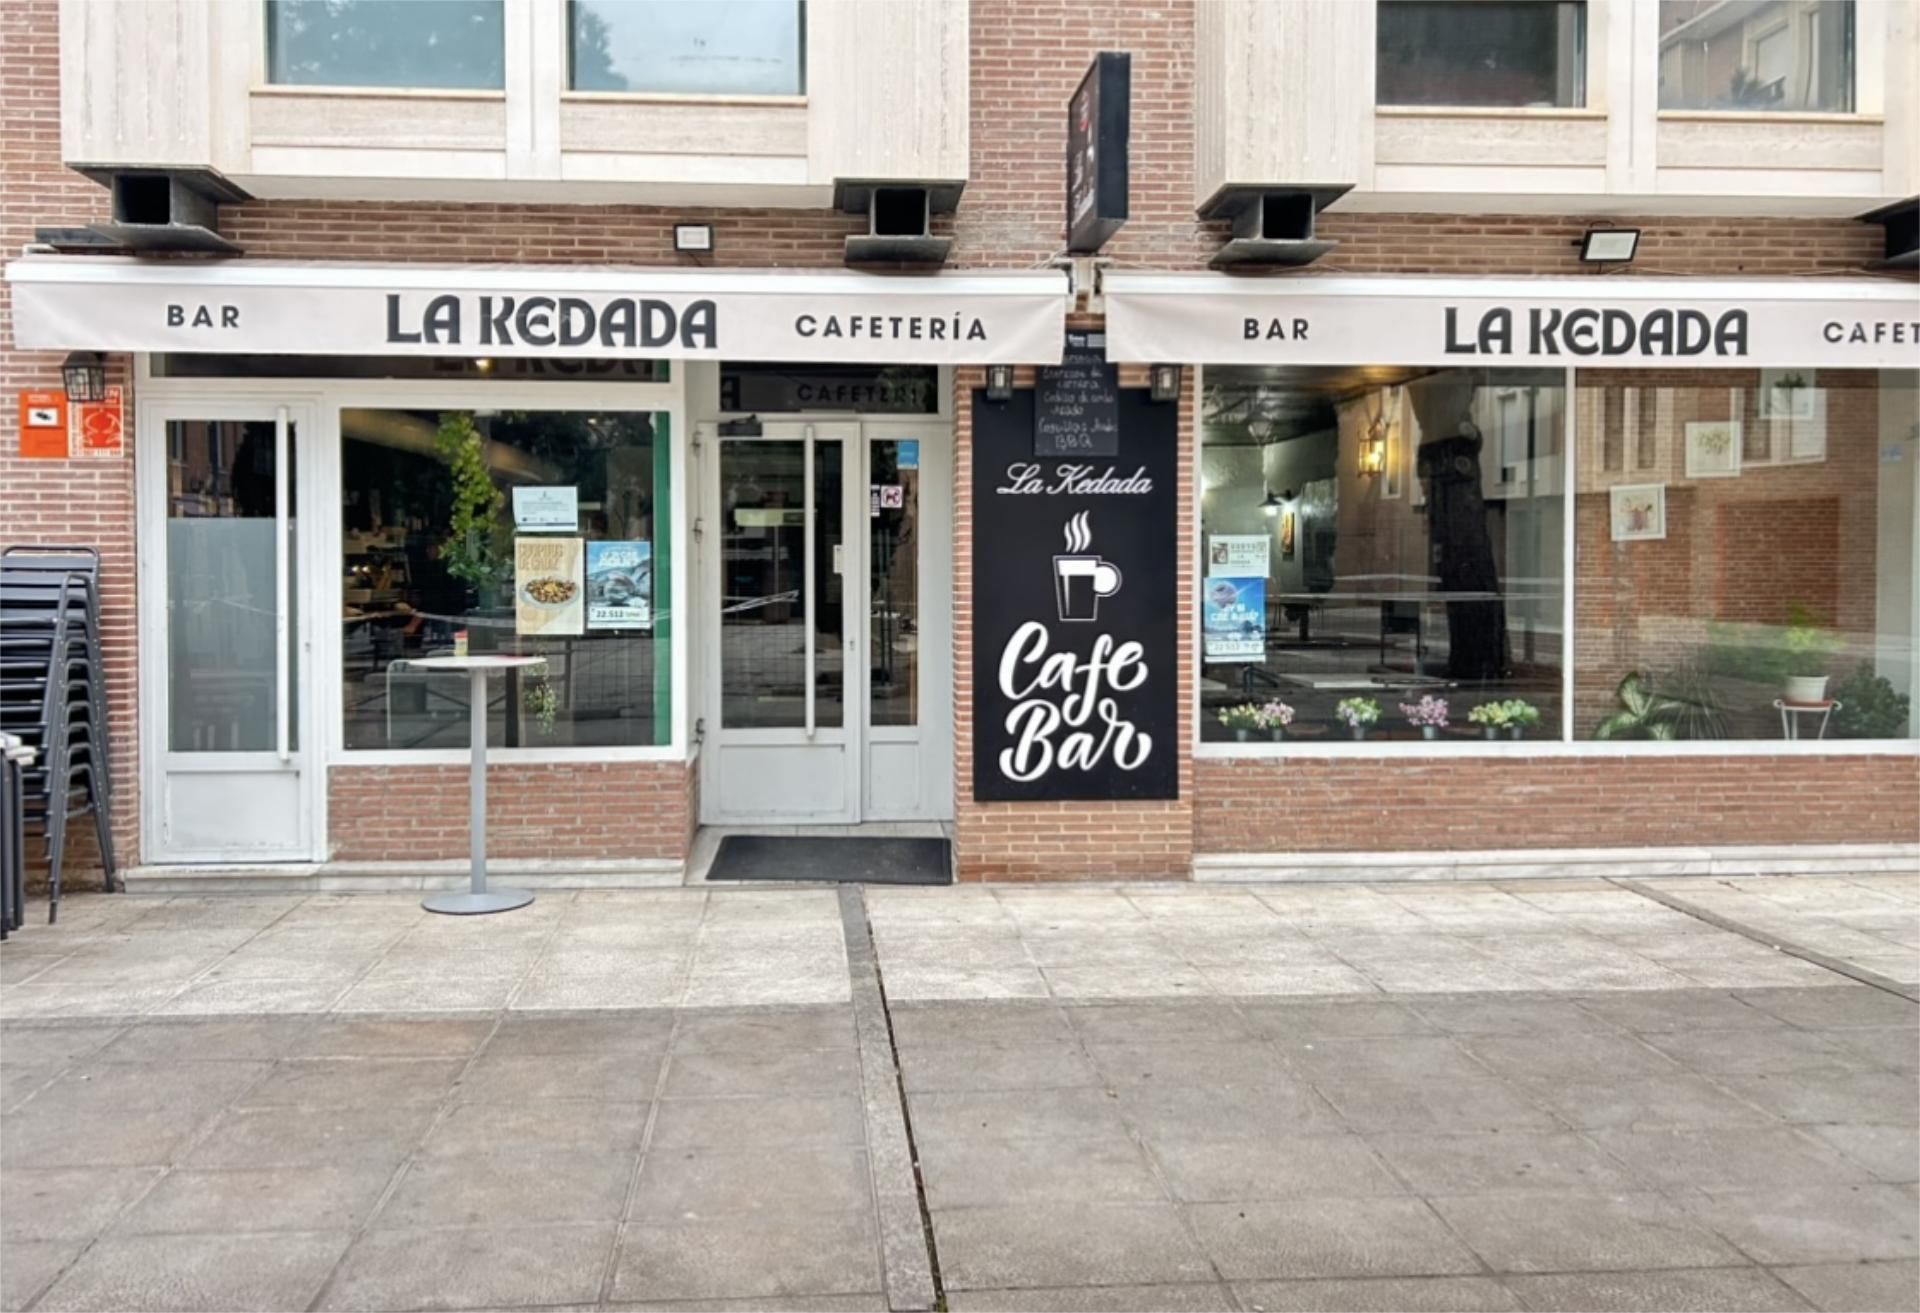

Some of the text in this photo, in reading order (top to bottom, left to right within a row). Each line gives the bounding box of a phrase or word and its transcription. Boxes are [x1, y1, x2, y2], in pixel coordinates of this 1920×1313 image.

[168, 306, 239, 328] BAR
[387, 294, 717, 349] LA KEDADA
[795, 312, 986, 340] CAFETERÍA
[1243, 318, 1309, 340] BAR
[1445, 307, 1748, 356] LA KEDADA
[1823, 321, 1920, 344] CAFET
[996, 463, 1153, 495] La Kedada
[999, 621, 1148, 726] Cafe
[999, 698, 1152, 782] Bar
